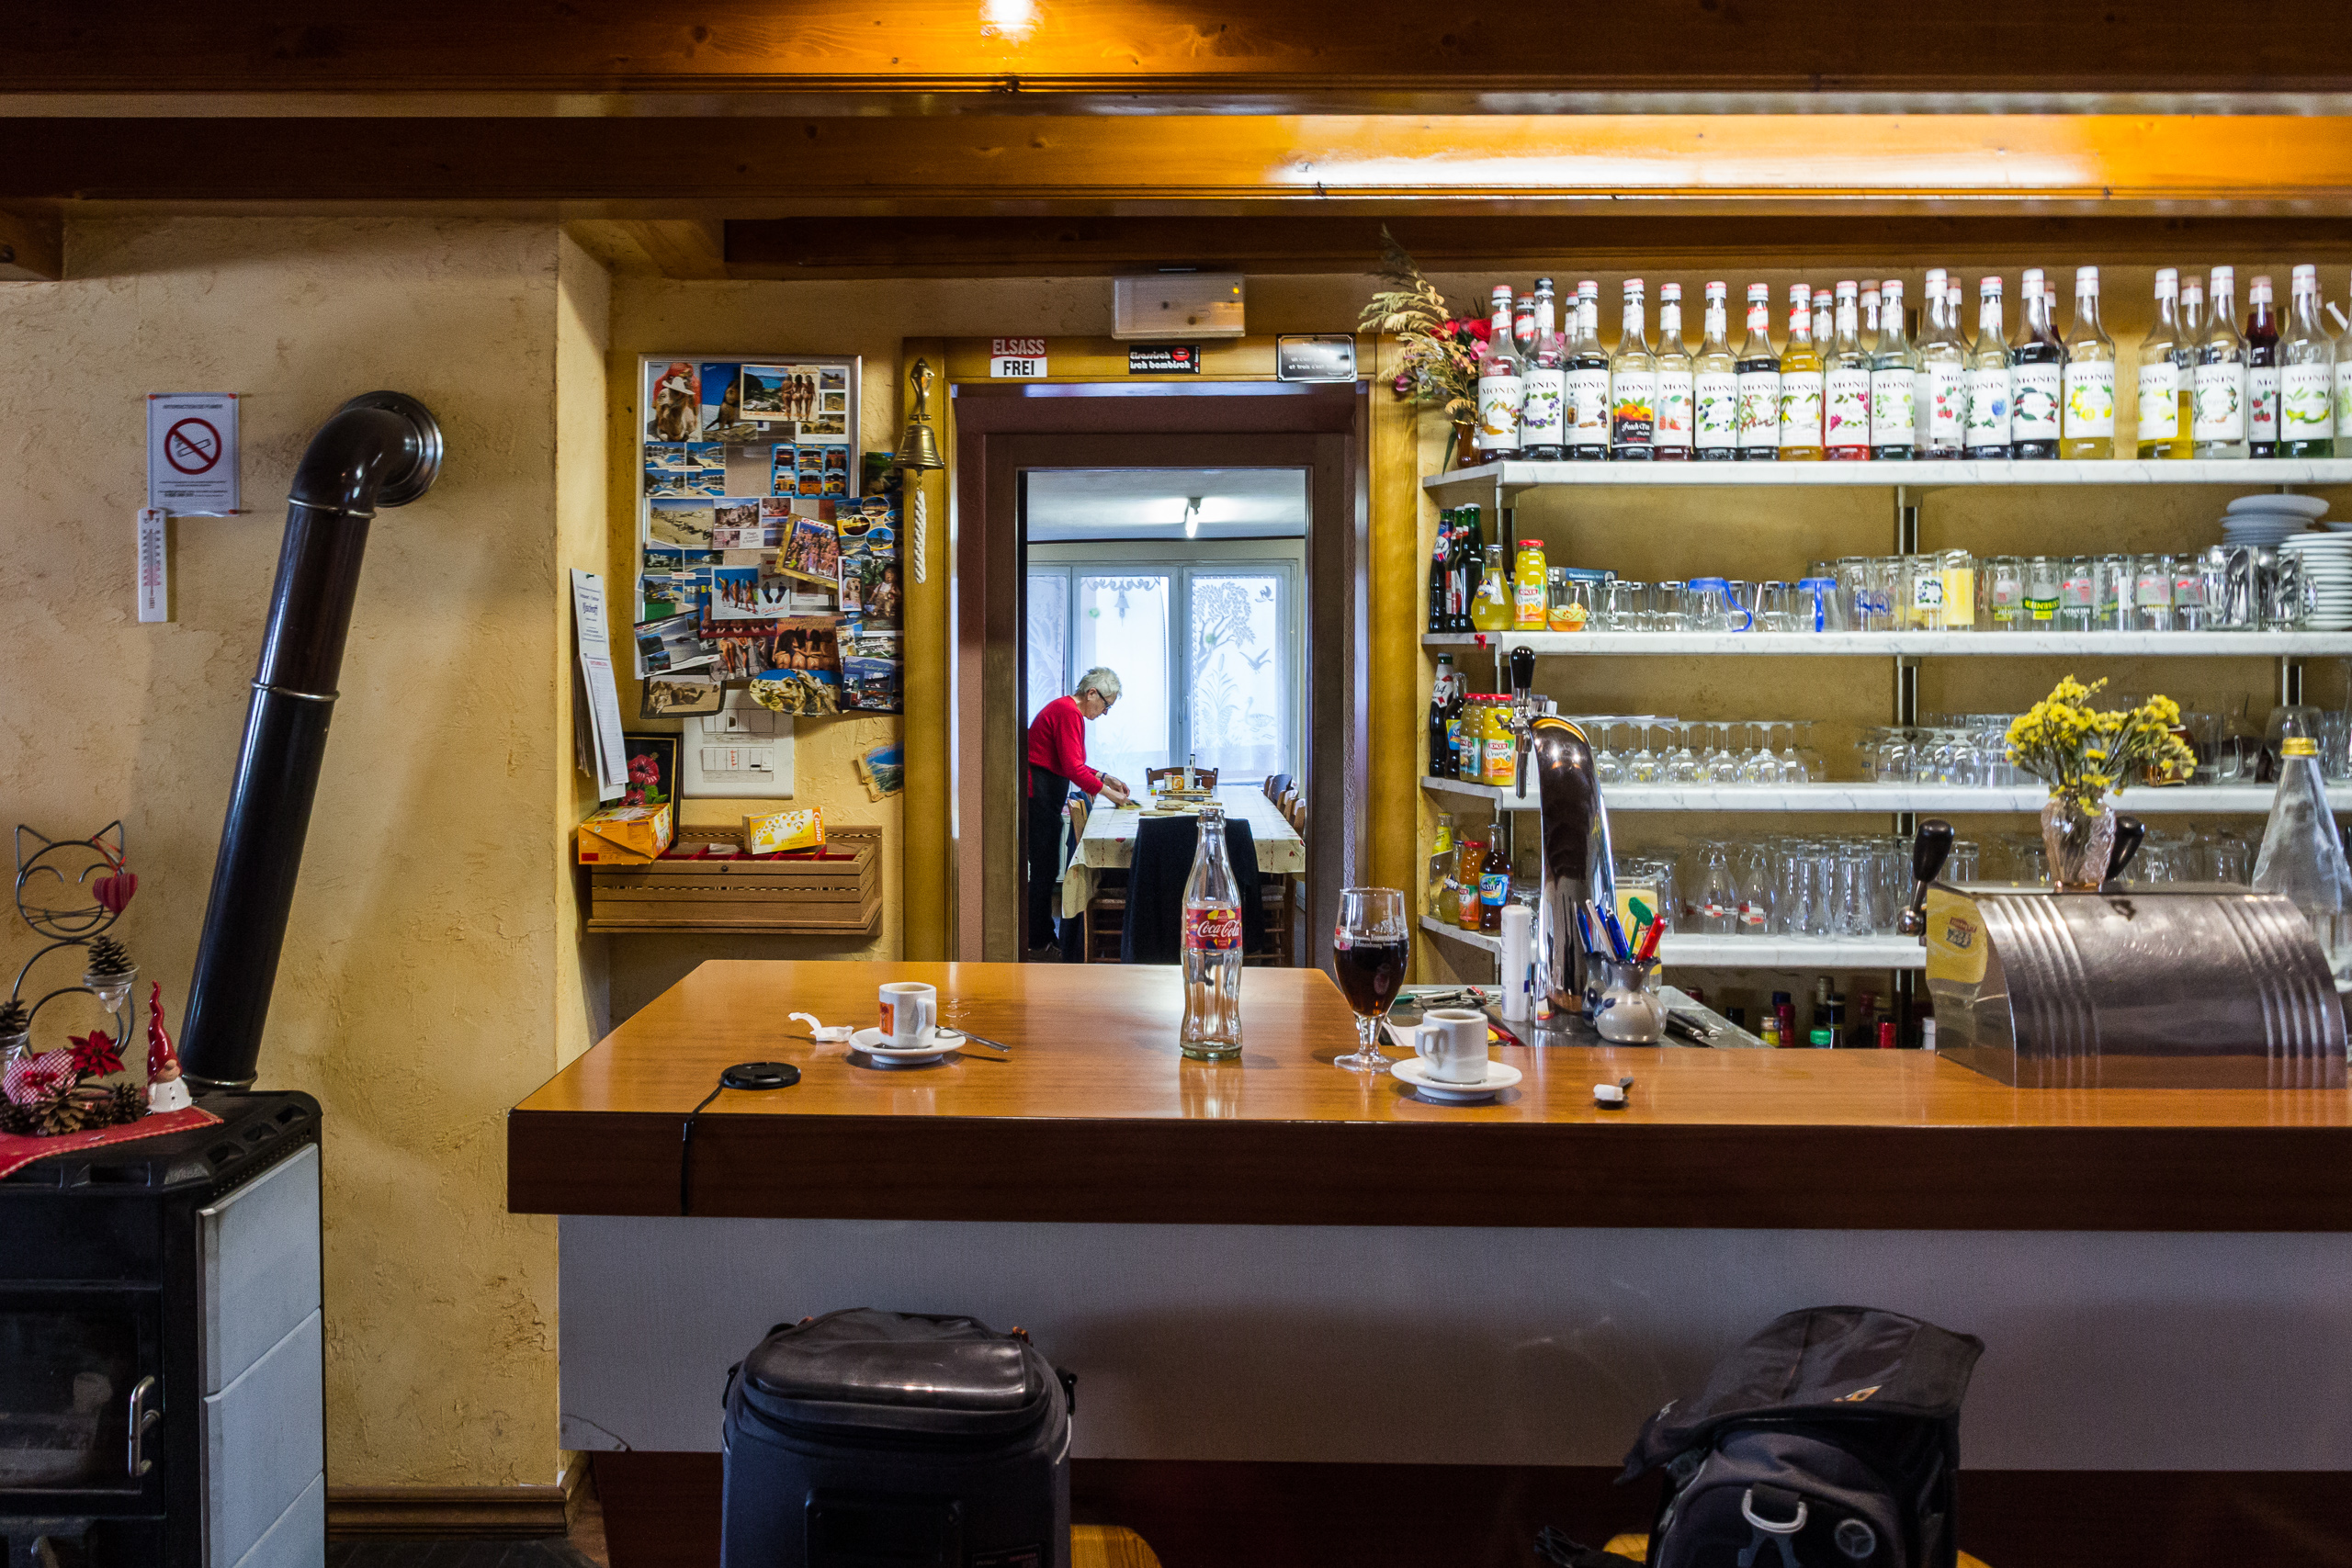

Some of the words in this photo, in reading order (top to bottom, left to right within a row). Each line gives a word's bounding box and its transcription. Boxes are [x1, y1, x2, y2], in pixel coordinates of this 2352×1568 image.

[993, 339, 1046, 355] ELSASS
[1003, 360, 1035, 376] FREI
[2016, 376, 2057, 385] MONIN
[2073, 374, 2113, 382] MONIN
[1568, 381, 1606, 390] MONIN
[1617, 384, 1654, 392] MONIN
[1742, 382, 1779, 390] MONIN
[1782, 383, 1820, 391] MONIN
[1832, 381, 1869, 389] MONIN
[1482, 387, 1517, 395] MONIN
[813, 812, 822, 841] Casino
